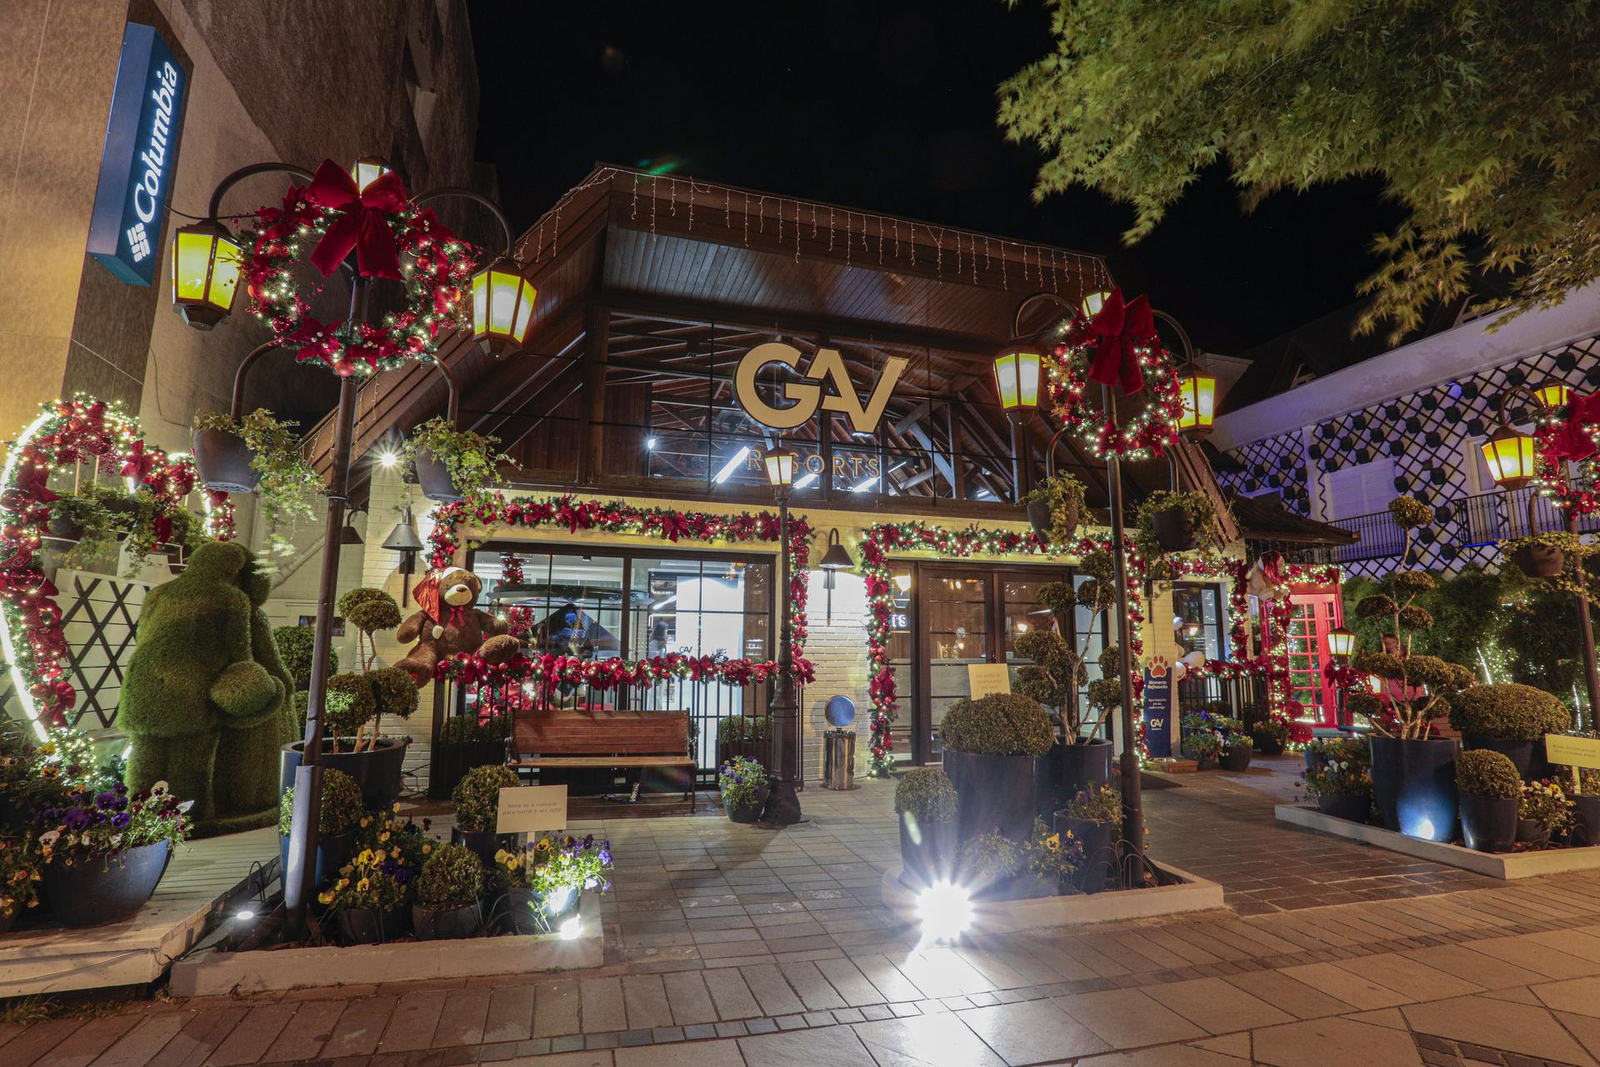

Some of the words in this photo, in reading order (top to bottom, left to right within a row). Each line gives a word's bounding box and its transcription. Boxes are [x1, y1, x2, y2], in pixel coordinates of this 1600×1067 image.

[134, 61, 178, 223] Columbia
[735, 342, 910, 434] GAV
[747, 449, 880, 479] RSORTS
[1150, 718, 1164, 727] GAV
